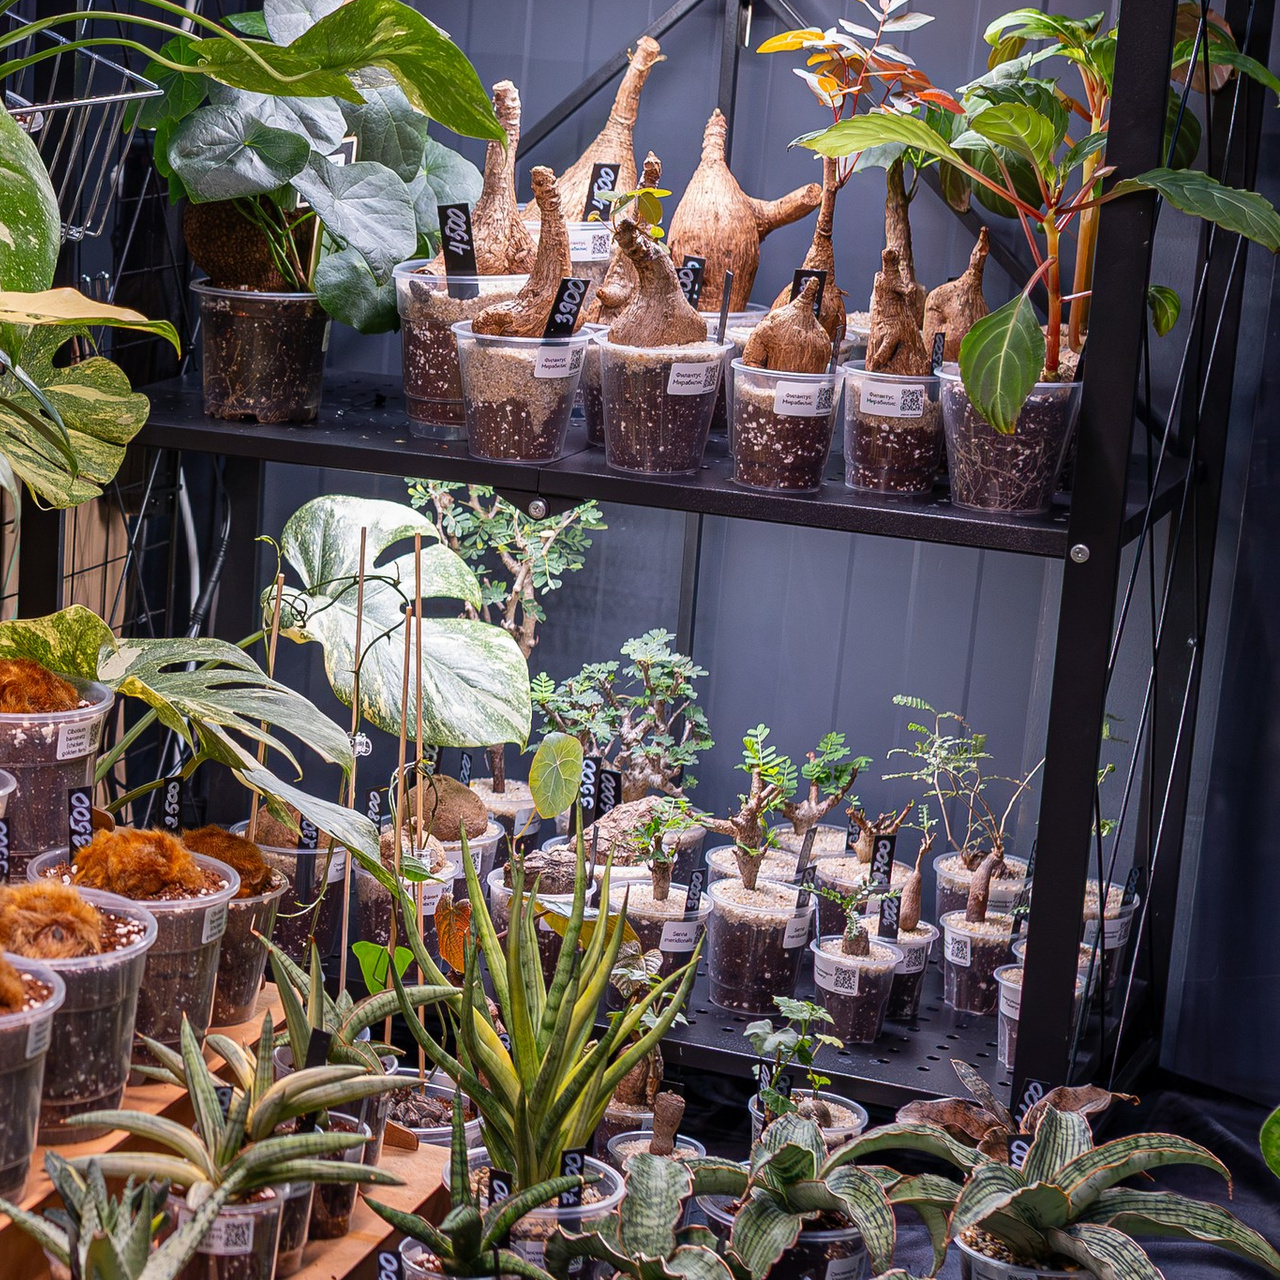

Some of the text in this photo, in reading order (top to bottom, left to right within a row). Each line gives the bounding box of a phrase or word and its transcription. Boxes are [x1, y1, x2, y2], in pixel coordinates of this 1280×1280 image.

[445, 208, 471, 256] 4500
[554, 280, 585, 325] 3900
[672, 378, 703, 387] Мирабилис
[785, 392, 812, 400] Филантус
[868, 391, 895, 400] Филантус
[782, 399, 813, 407] Мирабилис
[866, 398, 897, 407] Мирабилис
[69, 792, 92, 848] 3500
[686, 871, 703, 910] 3000
